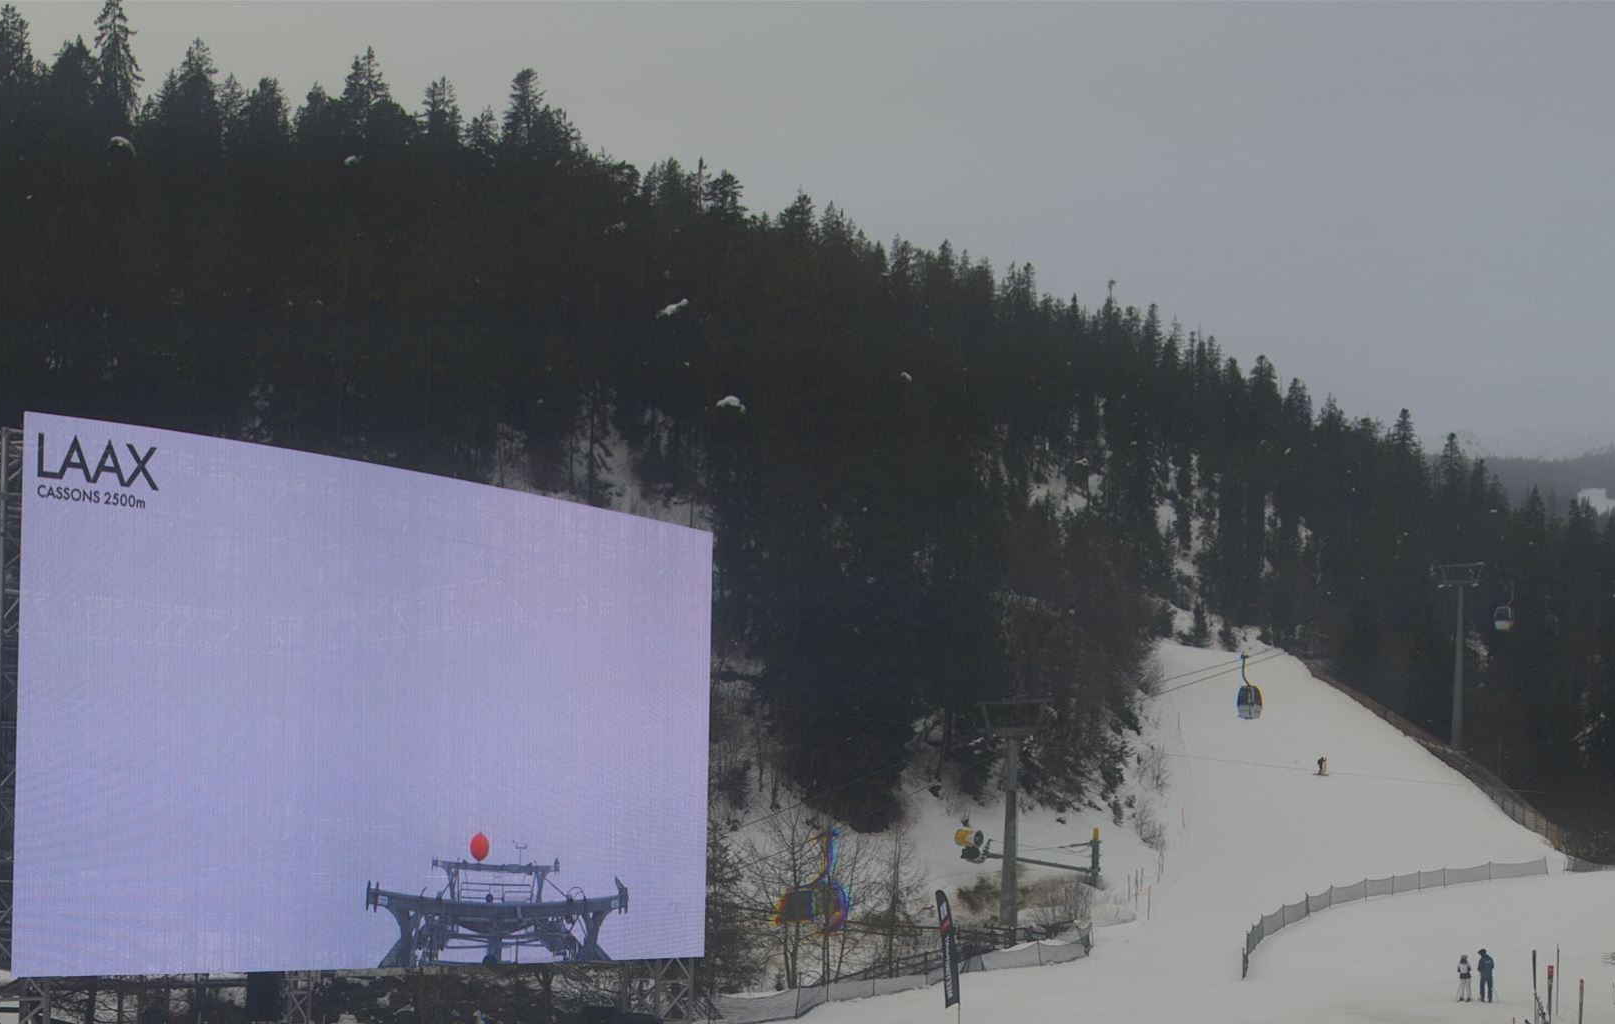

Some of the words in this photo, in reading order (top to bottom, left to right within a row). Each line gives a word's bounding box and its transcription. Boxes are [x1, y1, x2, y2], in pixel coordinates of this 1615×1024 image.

[37, 432, 159, 491] LAAX
[37, 484, 100, 504] CASSONS
[103, 491, 146, 509] 2500m
